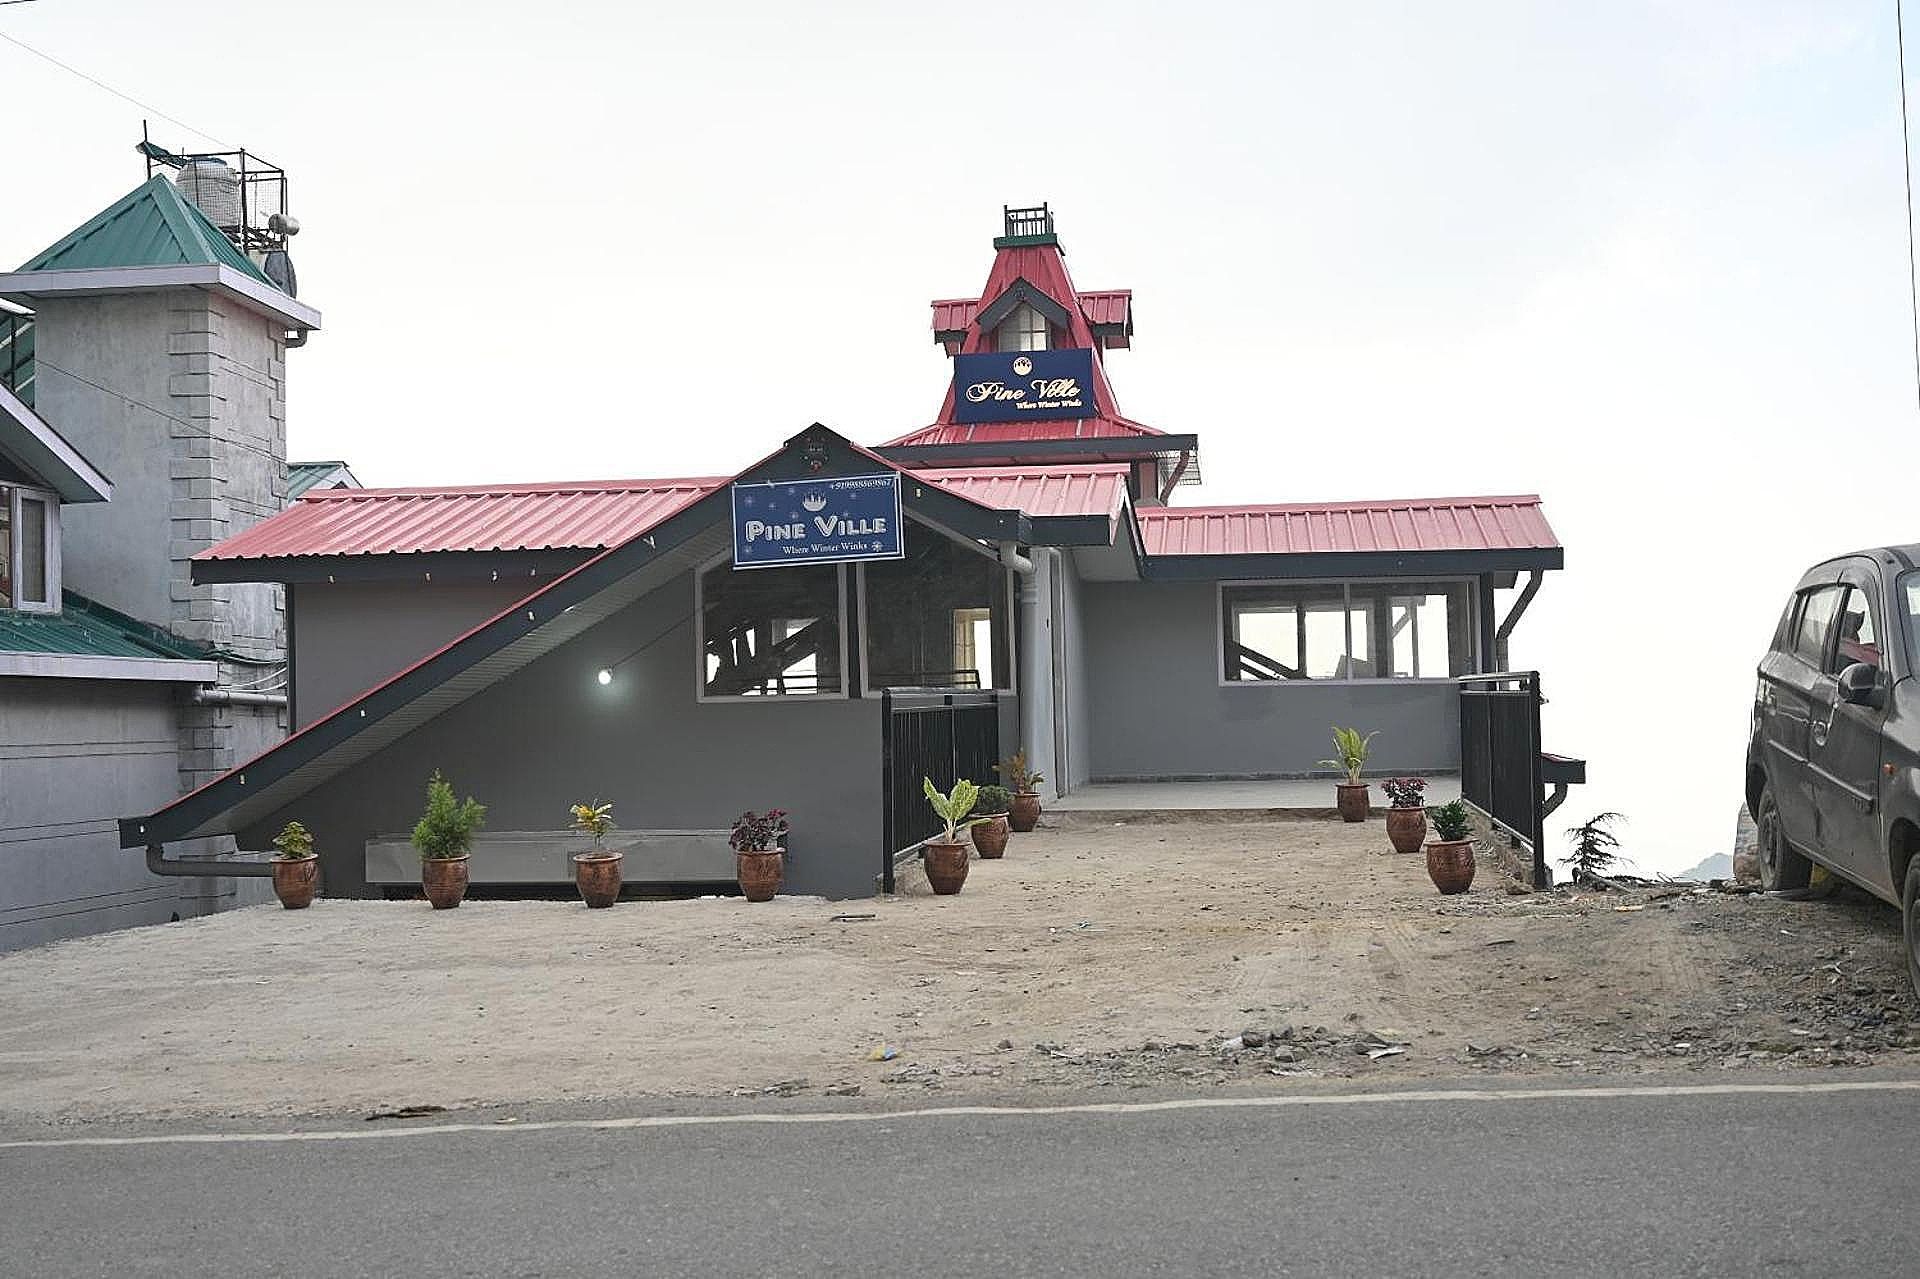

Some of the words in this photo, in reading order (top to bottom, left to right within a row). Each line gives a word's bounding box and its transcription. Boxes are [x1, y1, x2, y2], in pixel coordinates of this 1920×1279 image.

[966, 382, 1026, 402] Pine
[1031, 379, 1081, 398] Ville
[745, 520, 806, 543] PINE
[814, 515, 887, 537] VILLE
[782, 545, 809, 555] Where
[811, 543, 839, 554] Winter
[840, 541, 868, 552] Winks
